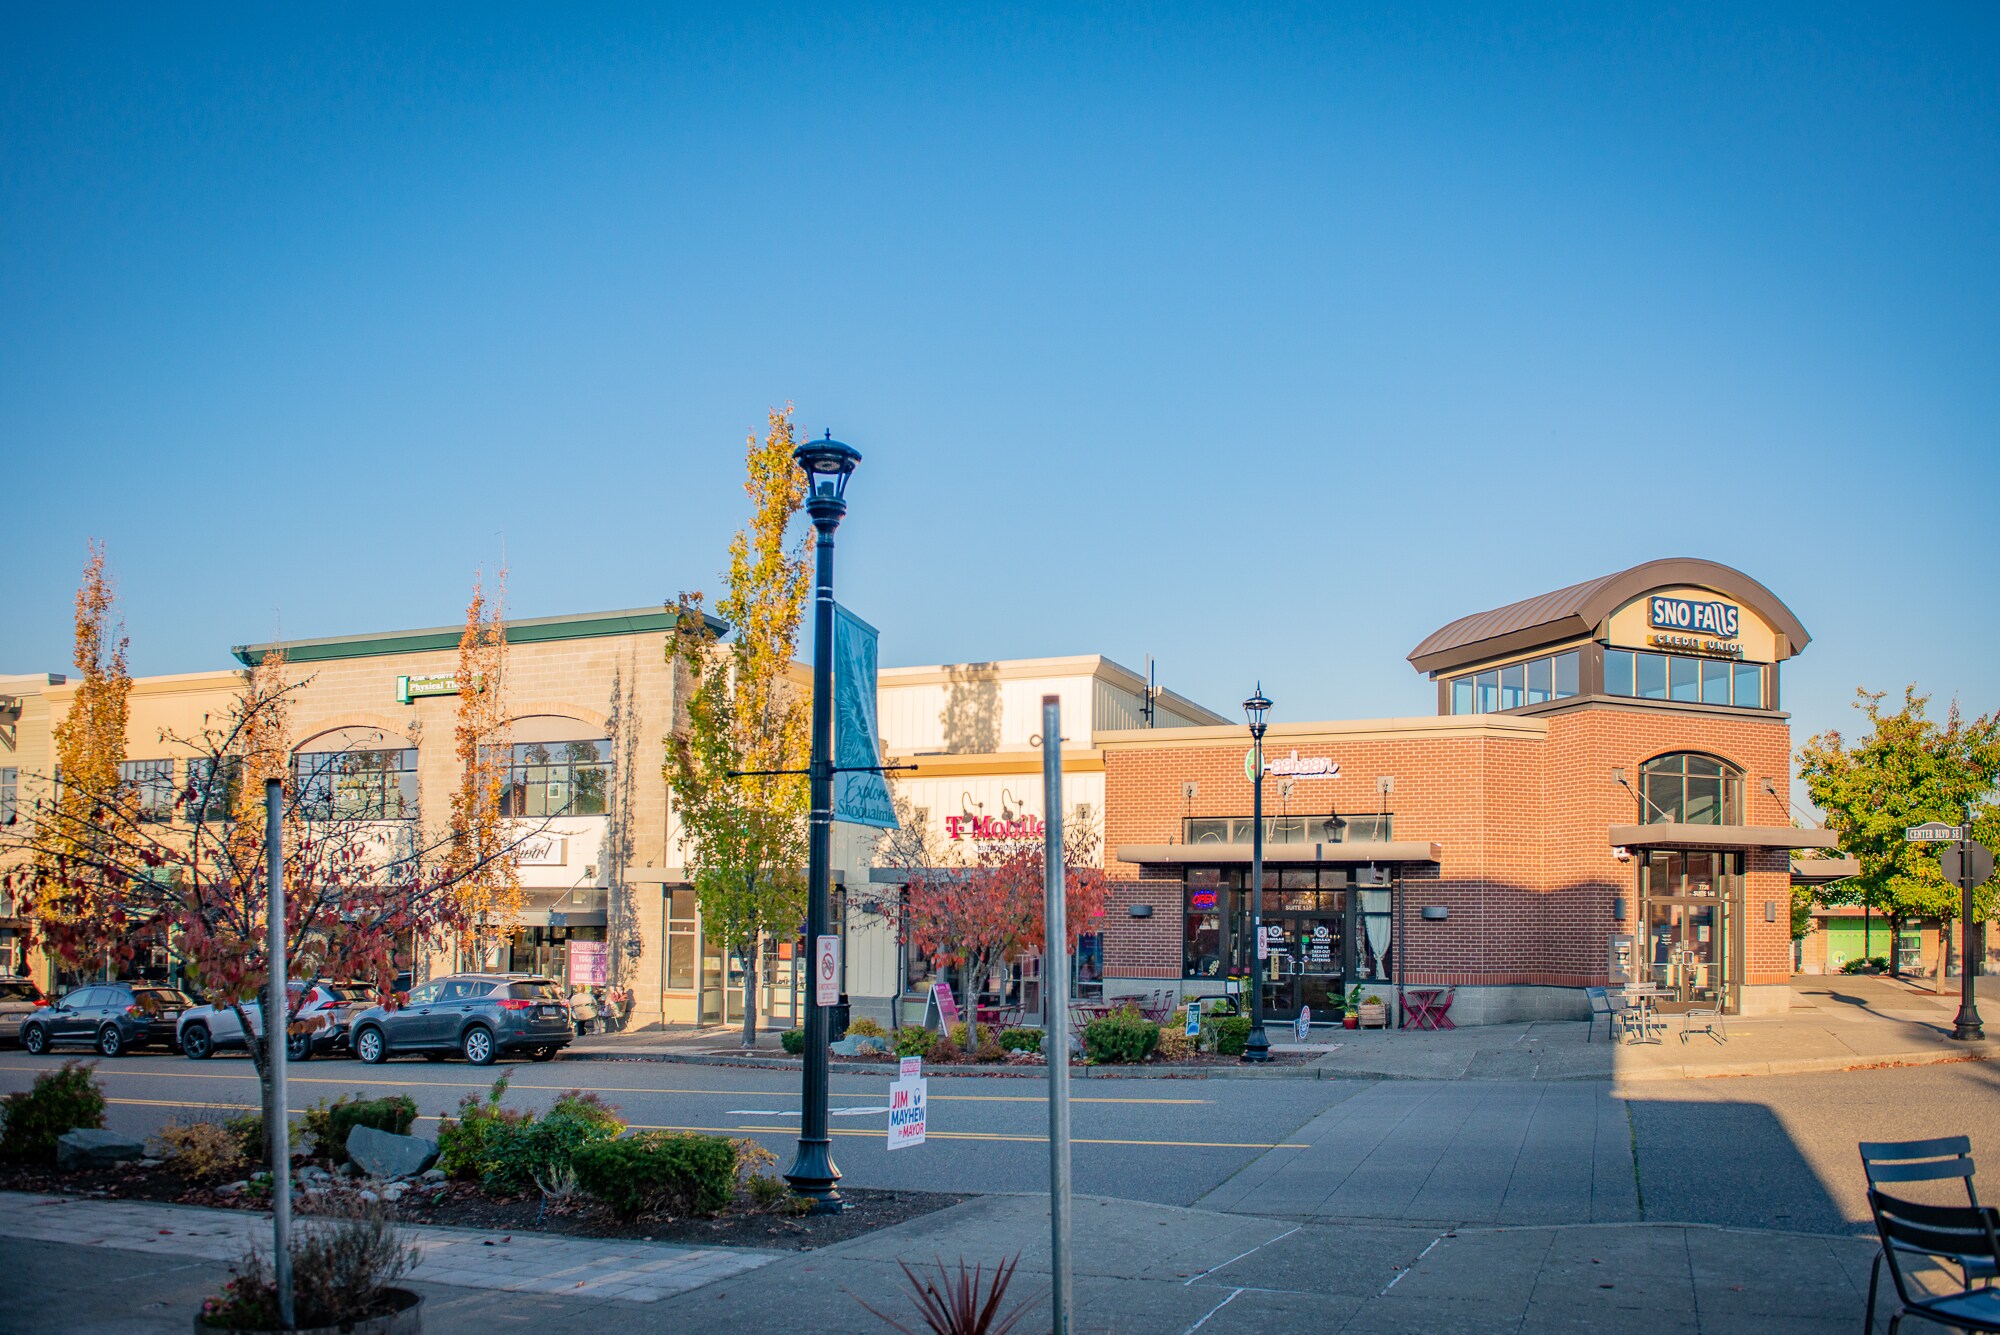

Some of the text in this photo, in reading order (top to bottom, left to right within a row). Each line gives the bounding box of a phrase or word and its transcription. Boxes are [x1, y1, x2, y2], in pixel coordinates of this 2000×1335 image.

[1654, 599, 1690, 626] SNO
[1657, 634, 1745, 653] CREDIT UNION
[410, 682, 444, 692] Physical
[1271, 750, 1339, 775] aahaan
[844, 776, 890, 806] Explore
[838, 799, 896, 823] Snoqualmie
[1910, 828, 1960, 839] CENTER BLVD SE
[1192, 893, 1217, 904] OPEN
[824, 942, 831, 951] NO
[892, 1090, 908, 1109] JIM
[891, 1105, 925, 1126] MAYHEW
[903, 1122, 924, 1138] MAYOR
